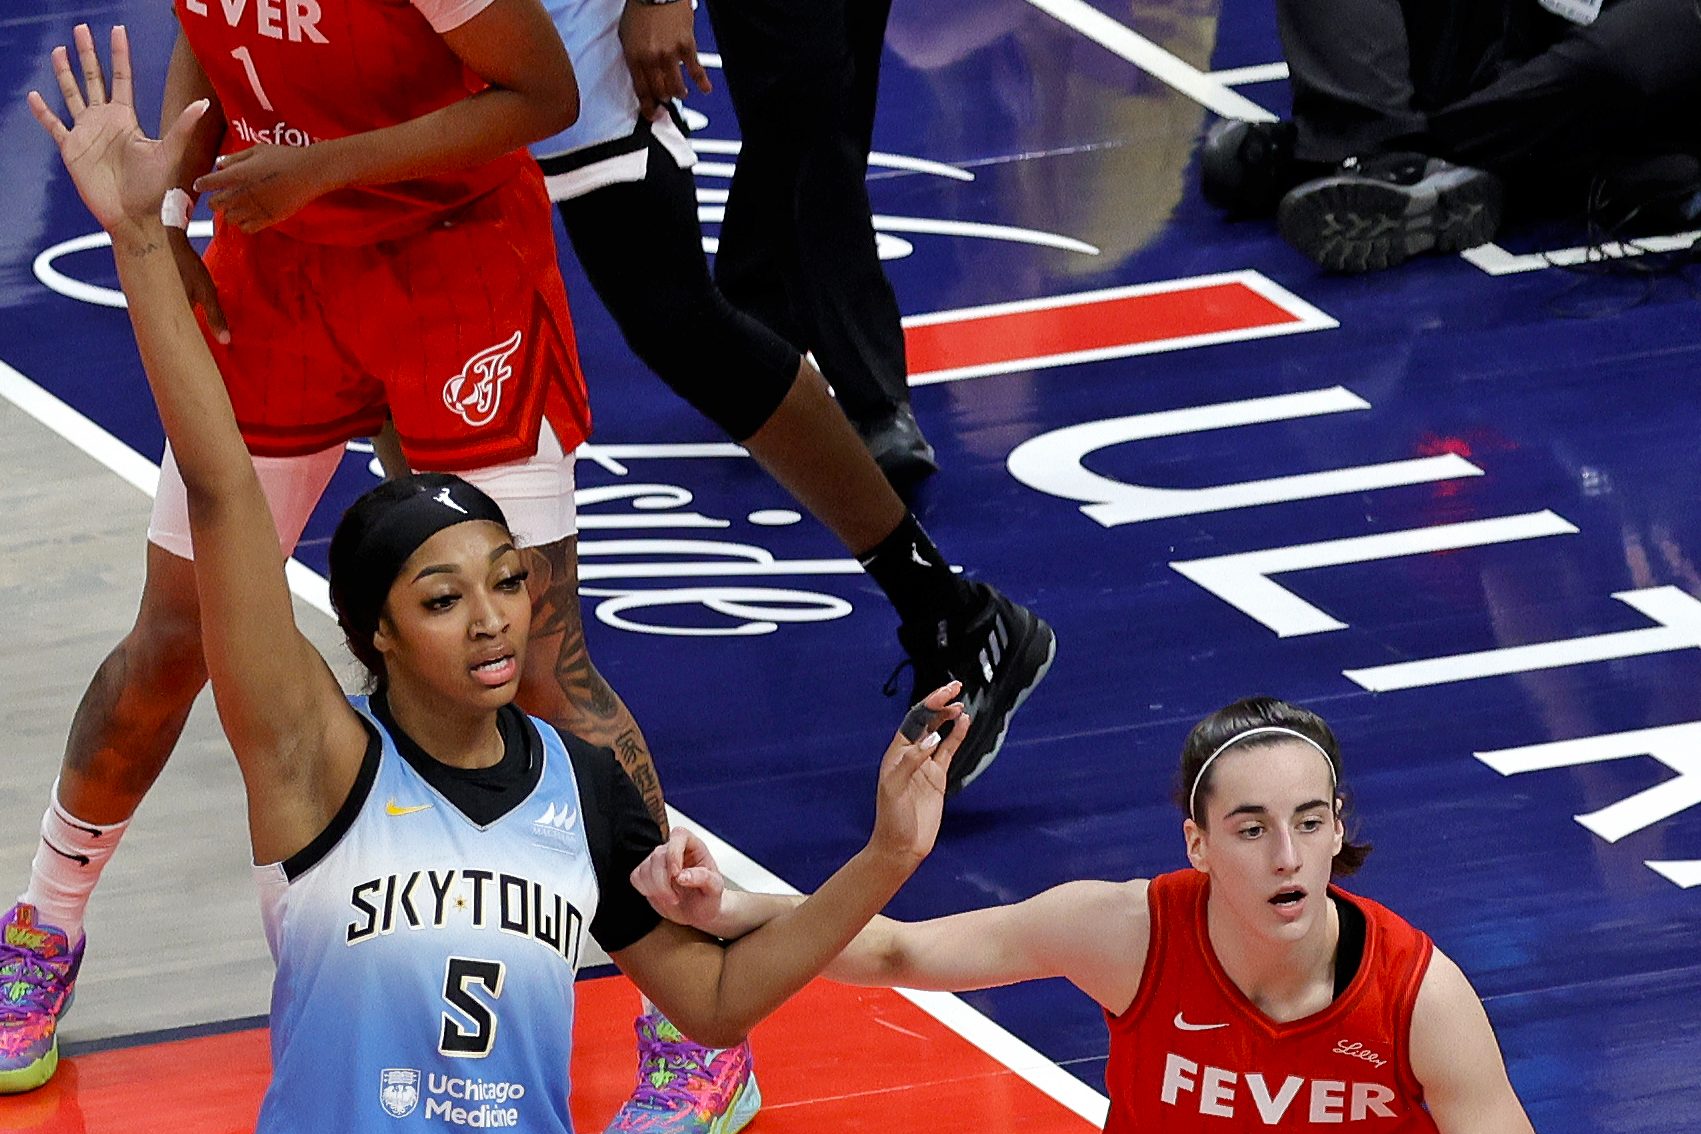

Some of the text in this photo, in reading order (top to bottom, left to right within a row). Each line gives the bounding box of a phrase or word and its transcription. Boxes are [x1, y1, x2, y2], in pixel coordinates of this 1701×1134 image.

[230, 46, 274, 112] 1
[437, 955, 507, 1059] 5
[1332, 1039, 1387, 1069] Lilly
[428, 1072, 525, 1103] UChicago
[1160, 1052, 1398, 1126] FEVER
[425, 1097, 518, 1128] Medicine
